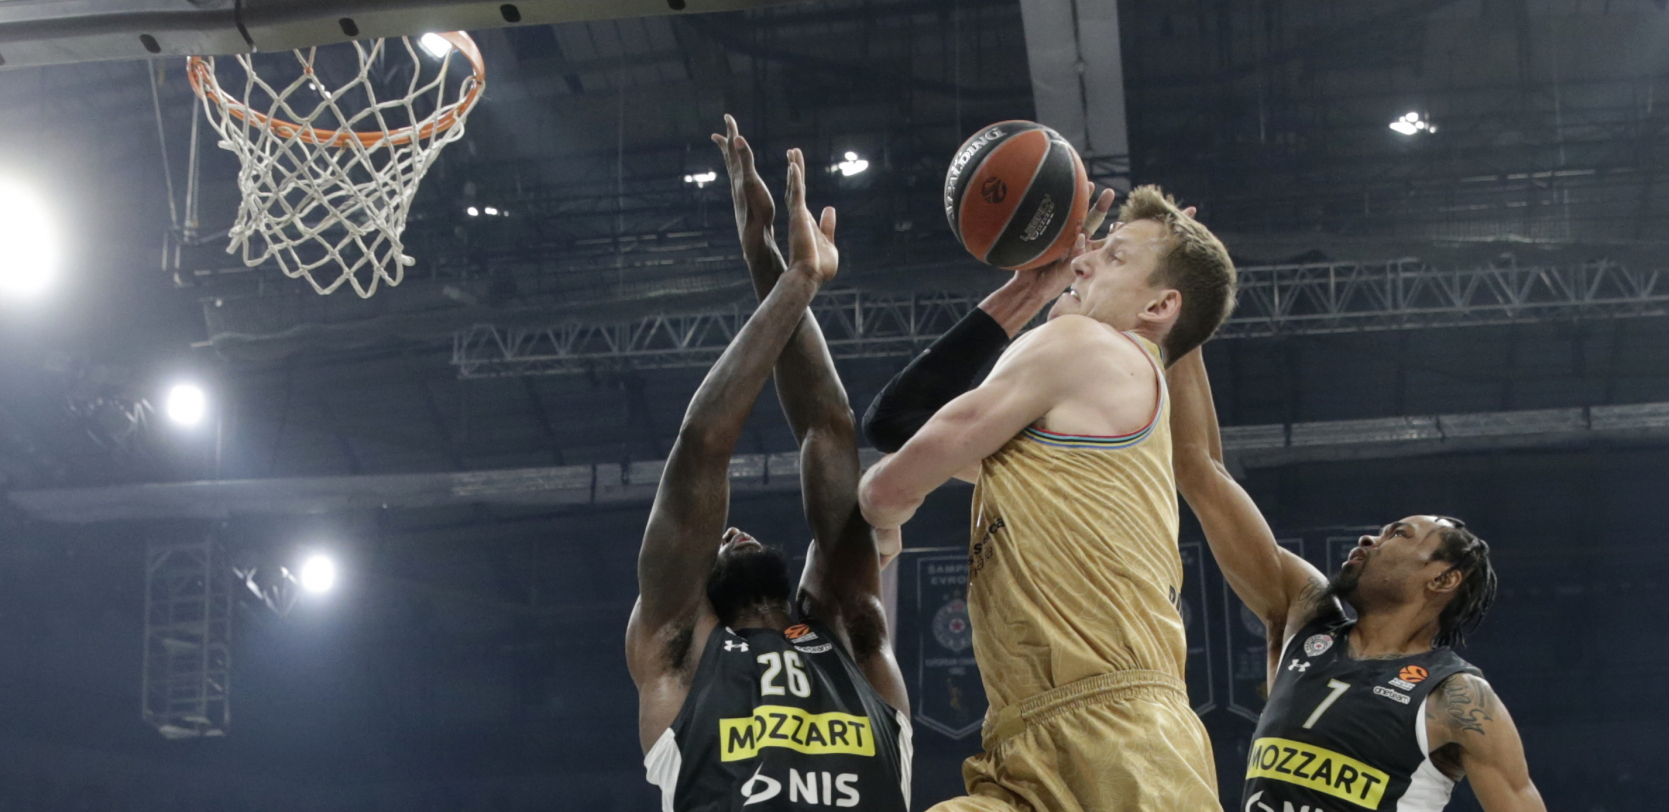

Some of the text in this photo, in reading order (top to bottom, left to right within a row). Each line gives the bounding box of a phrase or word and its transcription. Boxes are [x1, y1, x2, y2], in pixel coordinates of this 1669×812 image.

[757, 650, 810, 698] 26
[1374, 686, 1410, 704] oneteam
[1302, 678, 1350, 730] 7
[728, 712, 865, 753] MOZZART
[789, 768, 860, 807] NIS
[1248, 744, 1381, 800] MOZZART
